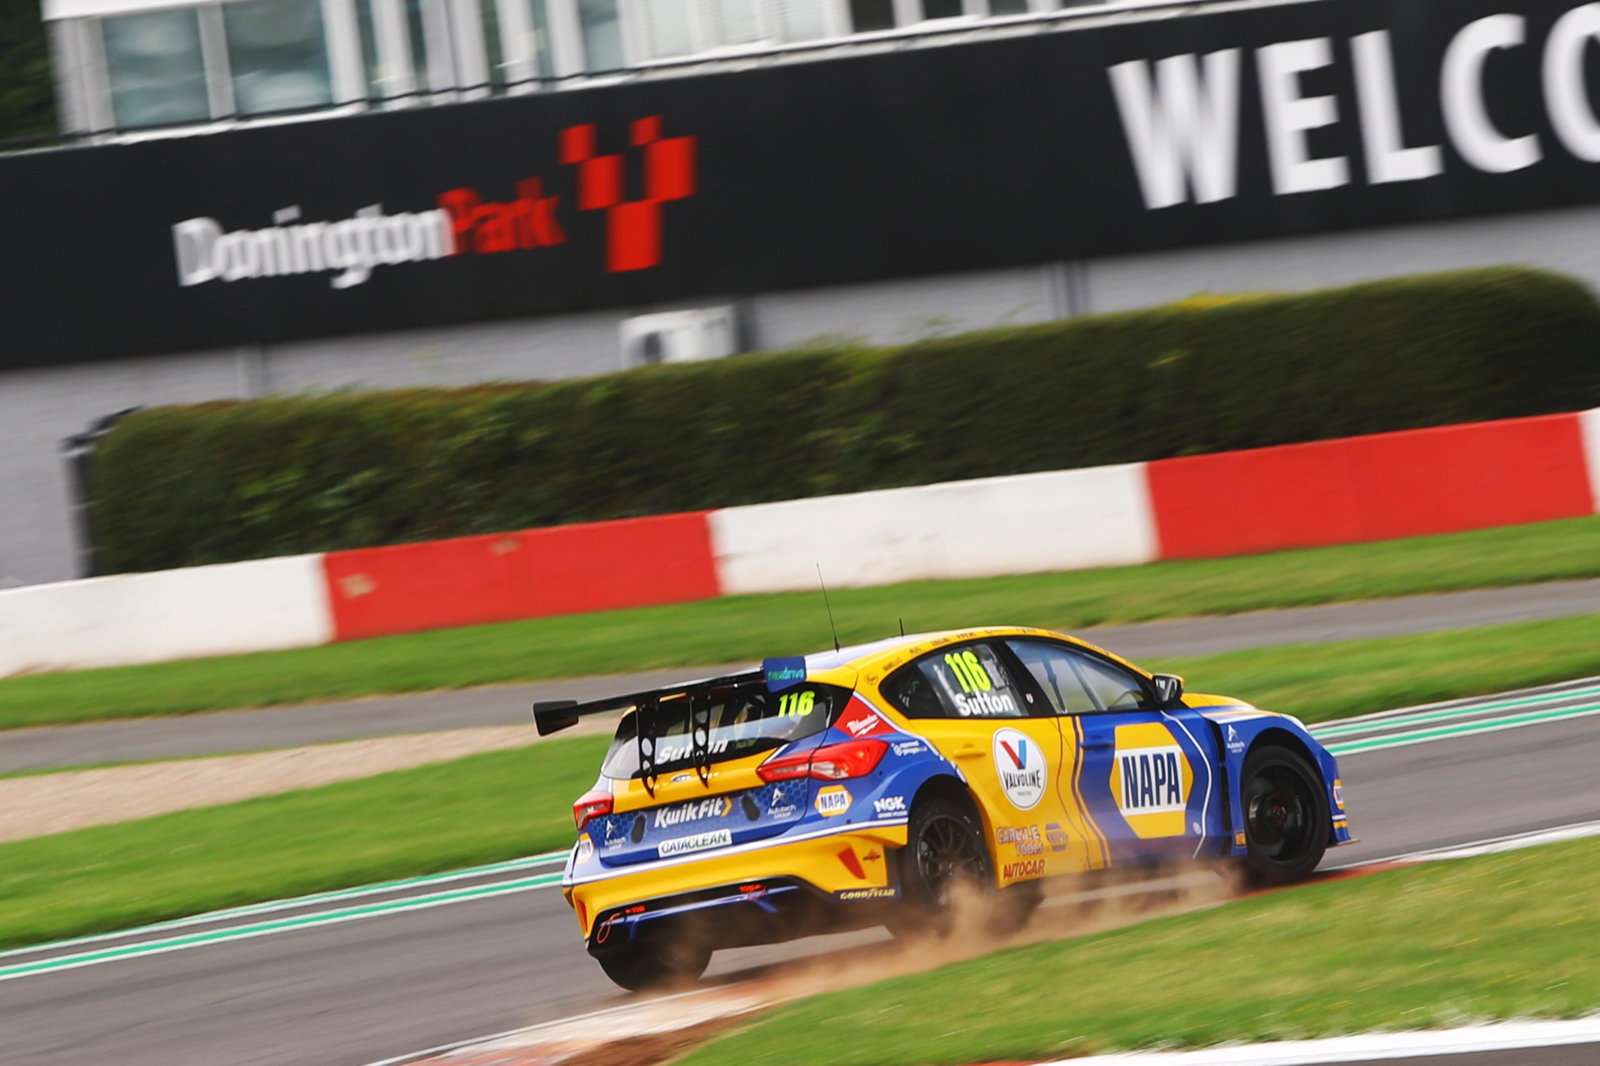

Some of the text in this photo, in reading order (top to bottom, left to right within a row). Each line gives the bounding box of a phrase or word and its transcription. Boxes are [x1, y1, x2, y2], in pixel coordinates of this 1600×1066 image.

[944, 650, 991, 693] 116
[778, 691, 815, 718] 116
[955, 690, 1014, 717] Sutton
[1003, 769, 1041, 790] VALVOLINE
[1122, 752, 1181, 809] NAPA
[820, 791, 847, 809] NAPA
[873, 796, 906, 813] NGK
[661, 835, 728, 854] CATACLEAN
[1003, 859, 1045, 879] AUTOCAR
[840, 887, 896, 901] GOODYEAR
